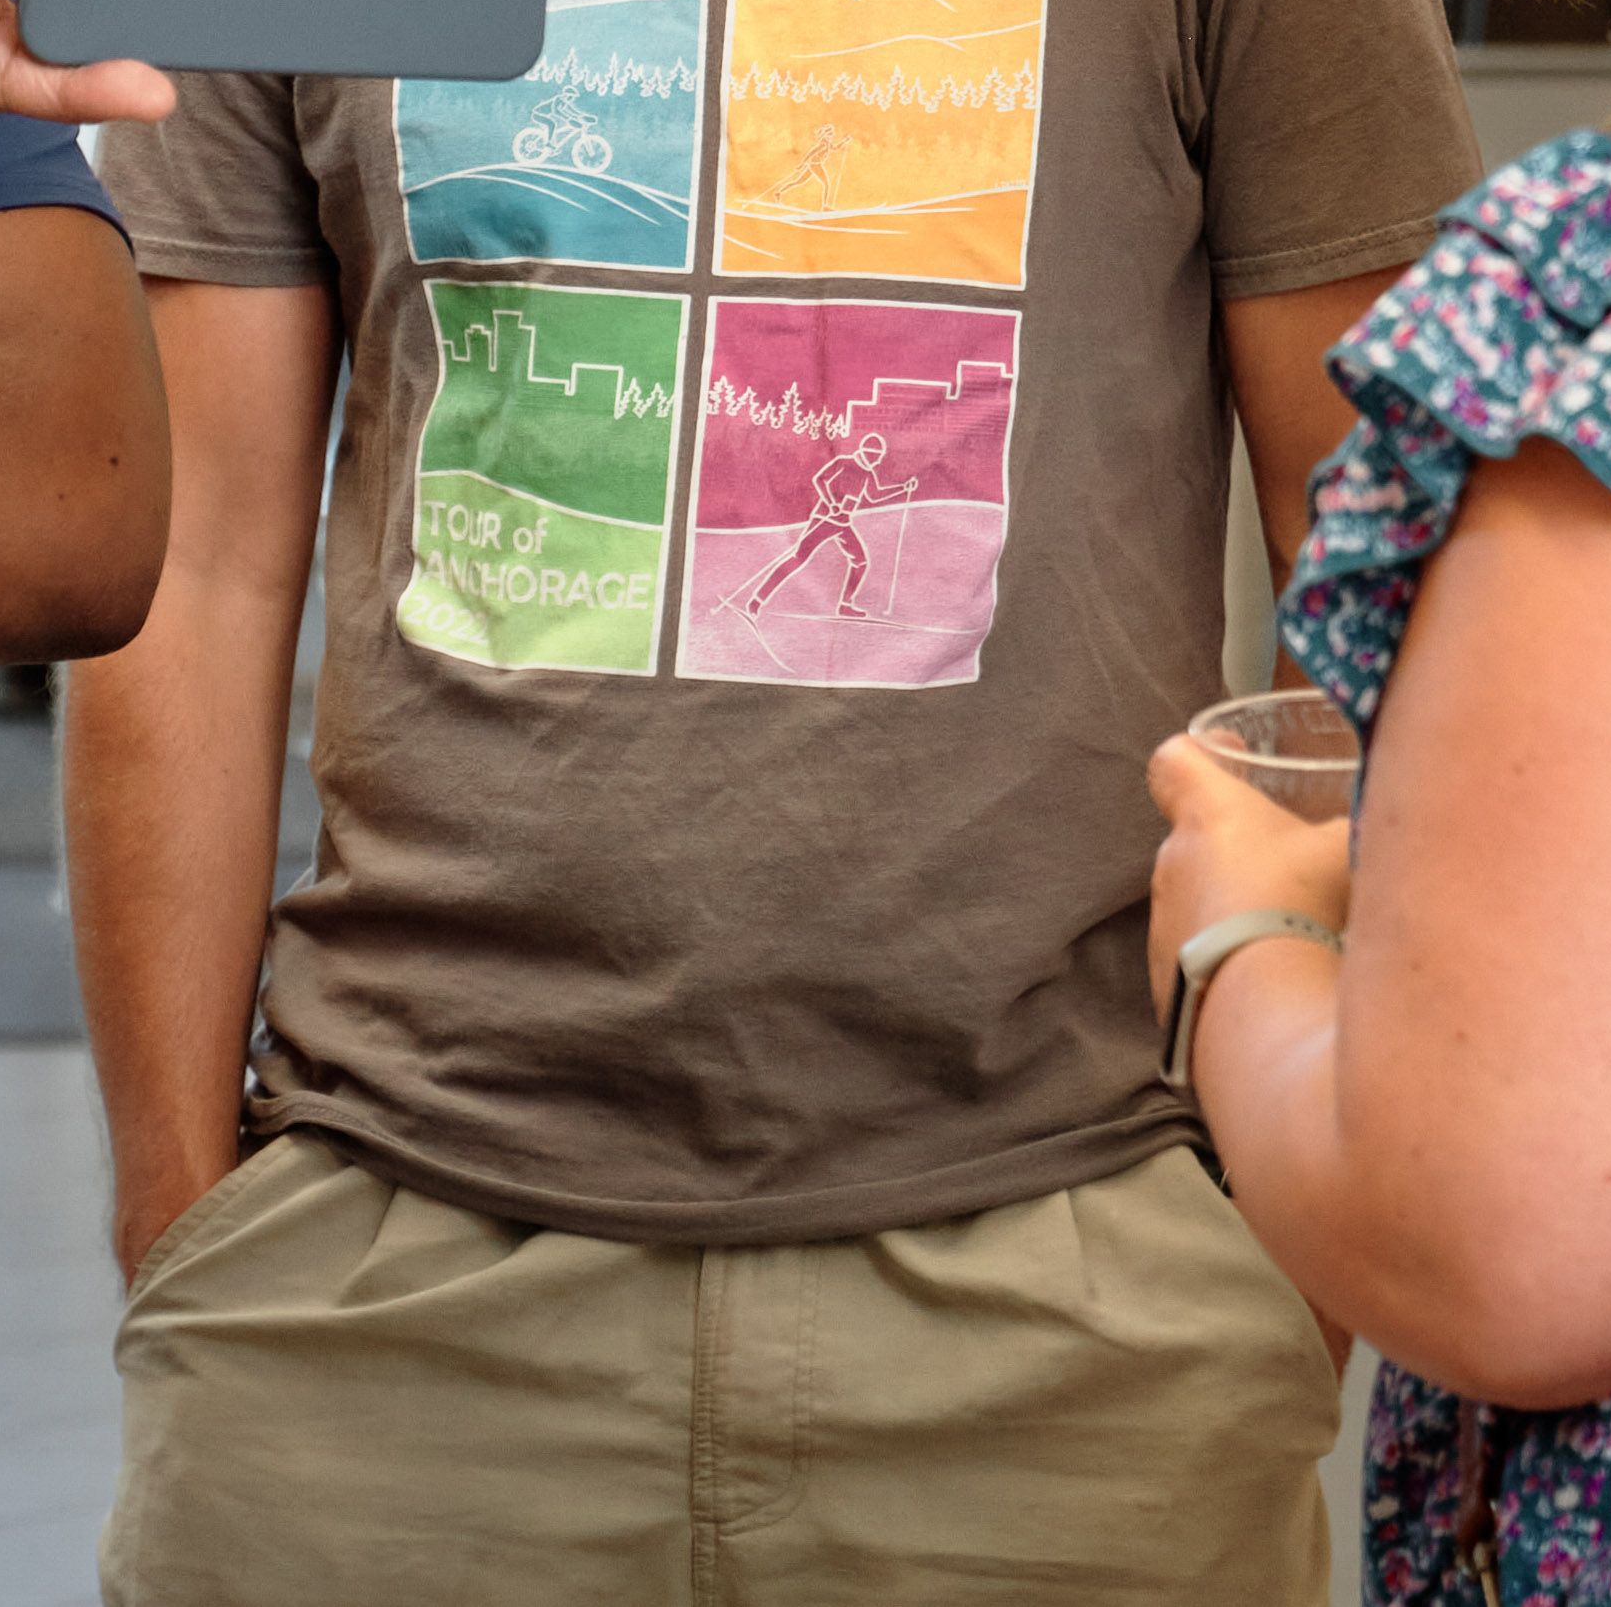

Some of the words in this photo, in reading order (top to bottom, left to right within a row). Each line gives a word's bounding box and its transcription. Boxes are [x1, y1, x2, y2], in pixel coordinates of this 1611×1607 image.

[423, 500, 503, 551] TOUR
[512, 516, 550, 555] of
[420, 549, 653, 611] ANCHORAGE
